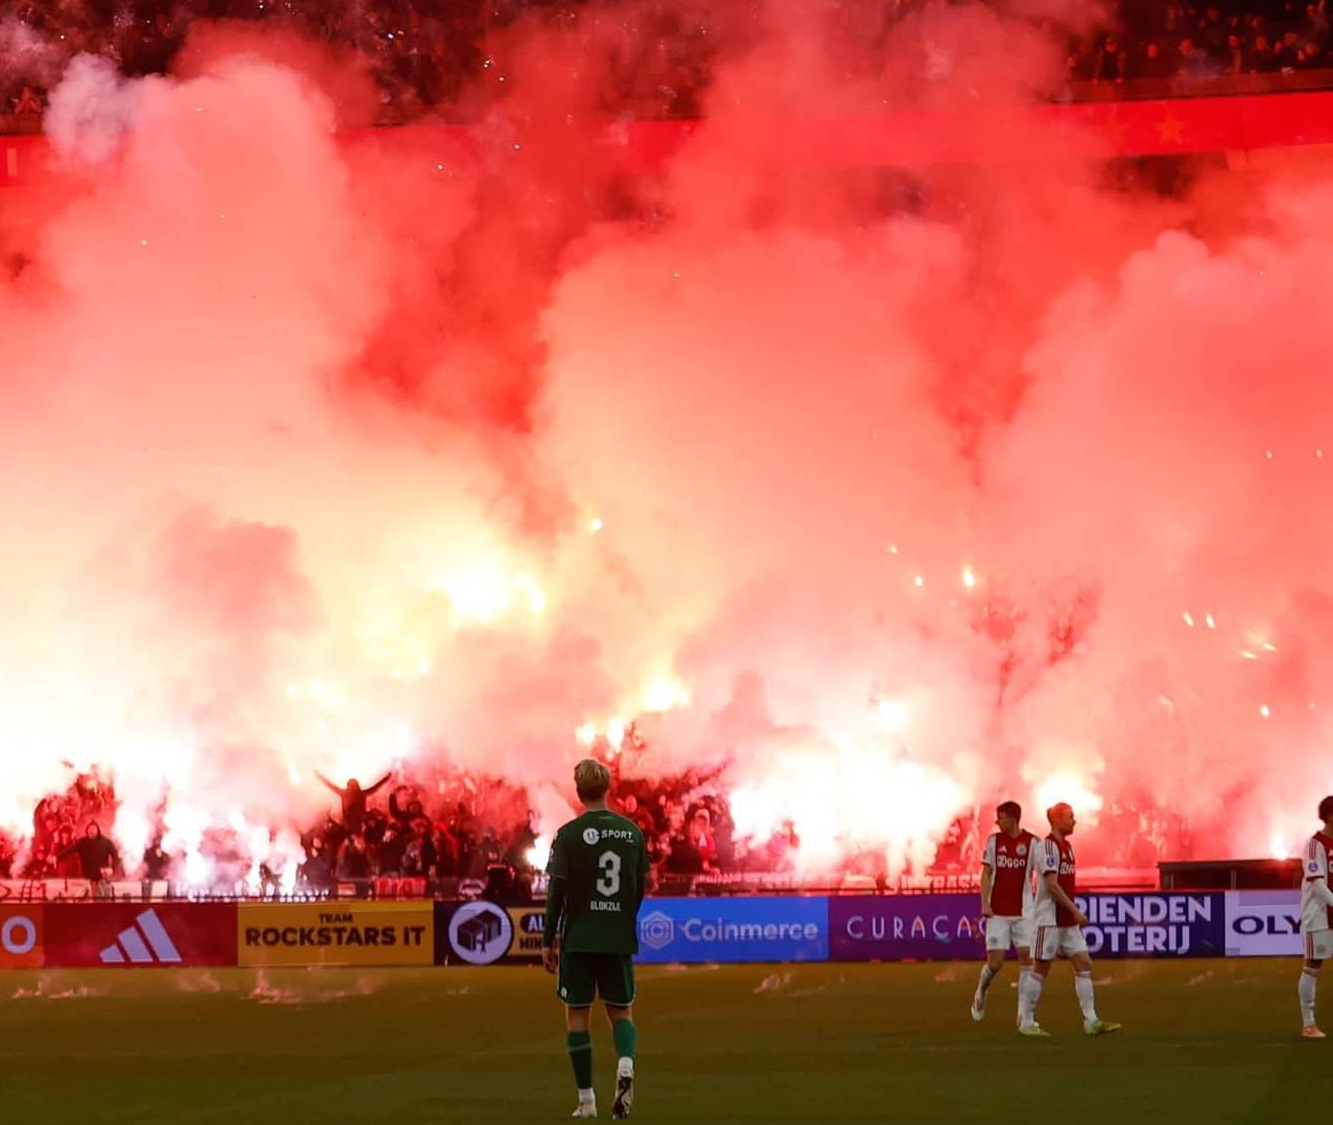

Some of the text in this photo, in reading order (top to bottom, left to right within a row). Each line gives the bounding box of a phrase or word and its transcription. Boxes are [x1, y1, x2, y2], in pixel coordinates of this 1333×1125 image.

[601, 830, 633, 839] SPORT
[597, 851, 621, 897] 3
[319, 913, 353, 923] TEAM
[684, 917, 818, 942] Coinmerce
[847, 915, 987, 943] CURAÇA
[245, 927, 425, 946] ROCKSTARS IT
[1083, 925, 1190, 954] OTERIJ
